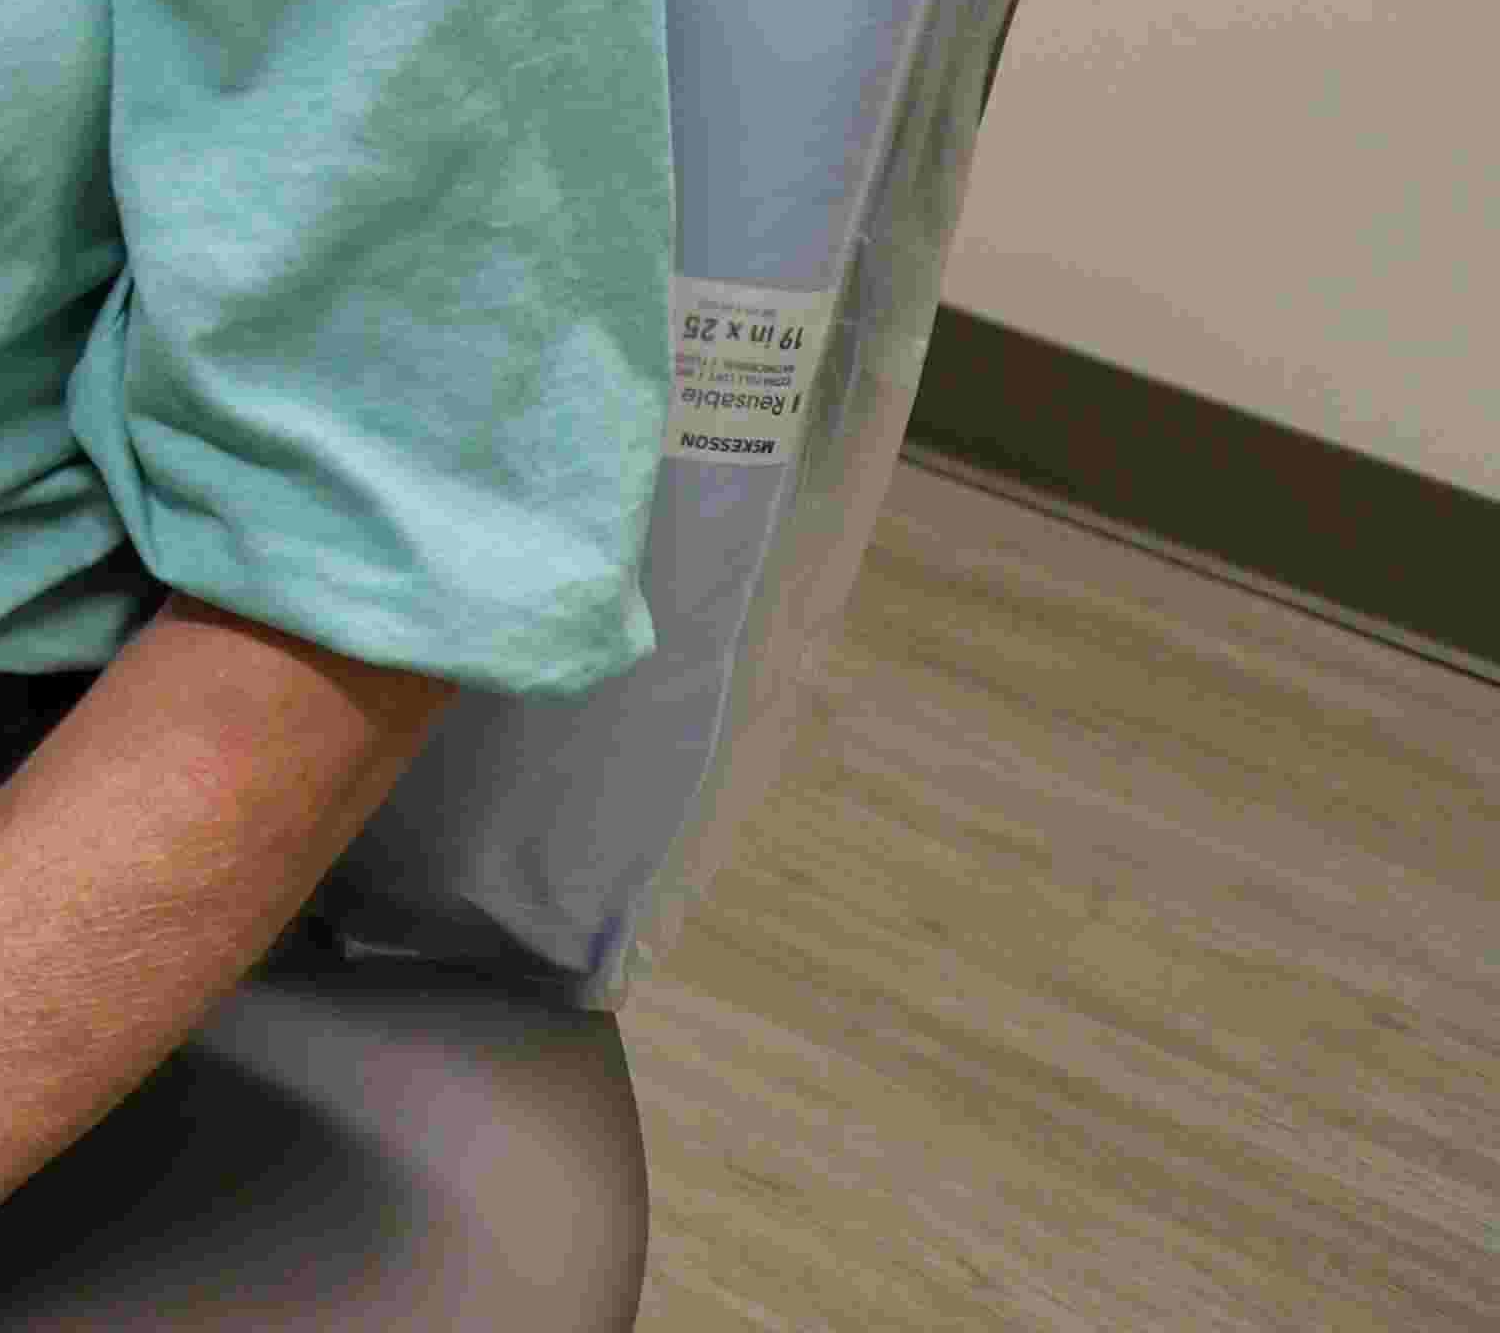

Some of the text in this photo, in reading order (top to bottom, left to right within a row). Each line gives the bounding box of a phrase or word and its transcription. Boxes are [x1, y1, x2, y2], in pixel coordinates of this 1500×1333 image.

[683, 316, 719, 341] 25
[726, 320, 742, 341] x
[750, 324, 775, 349] in
[681, 388, 785, 416] Reusable
